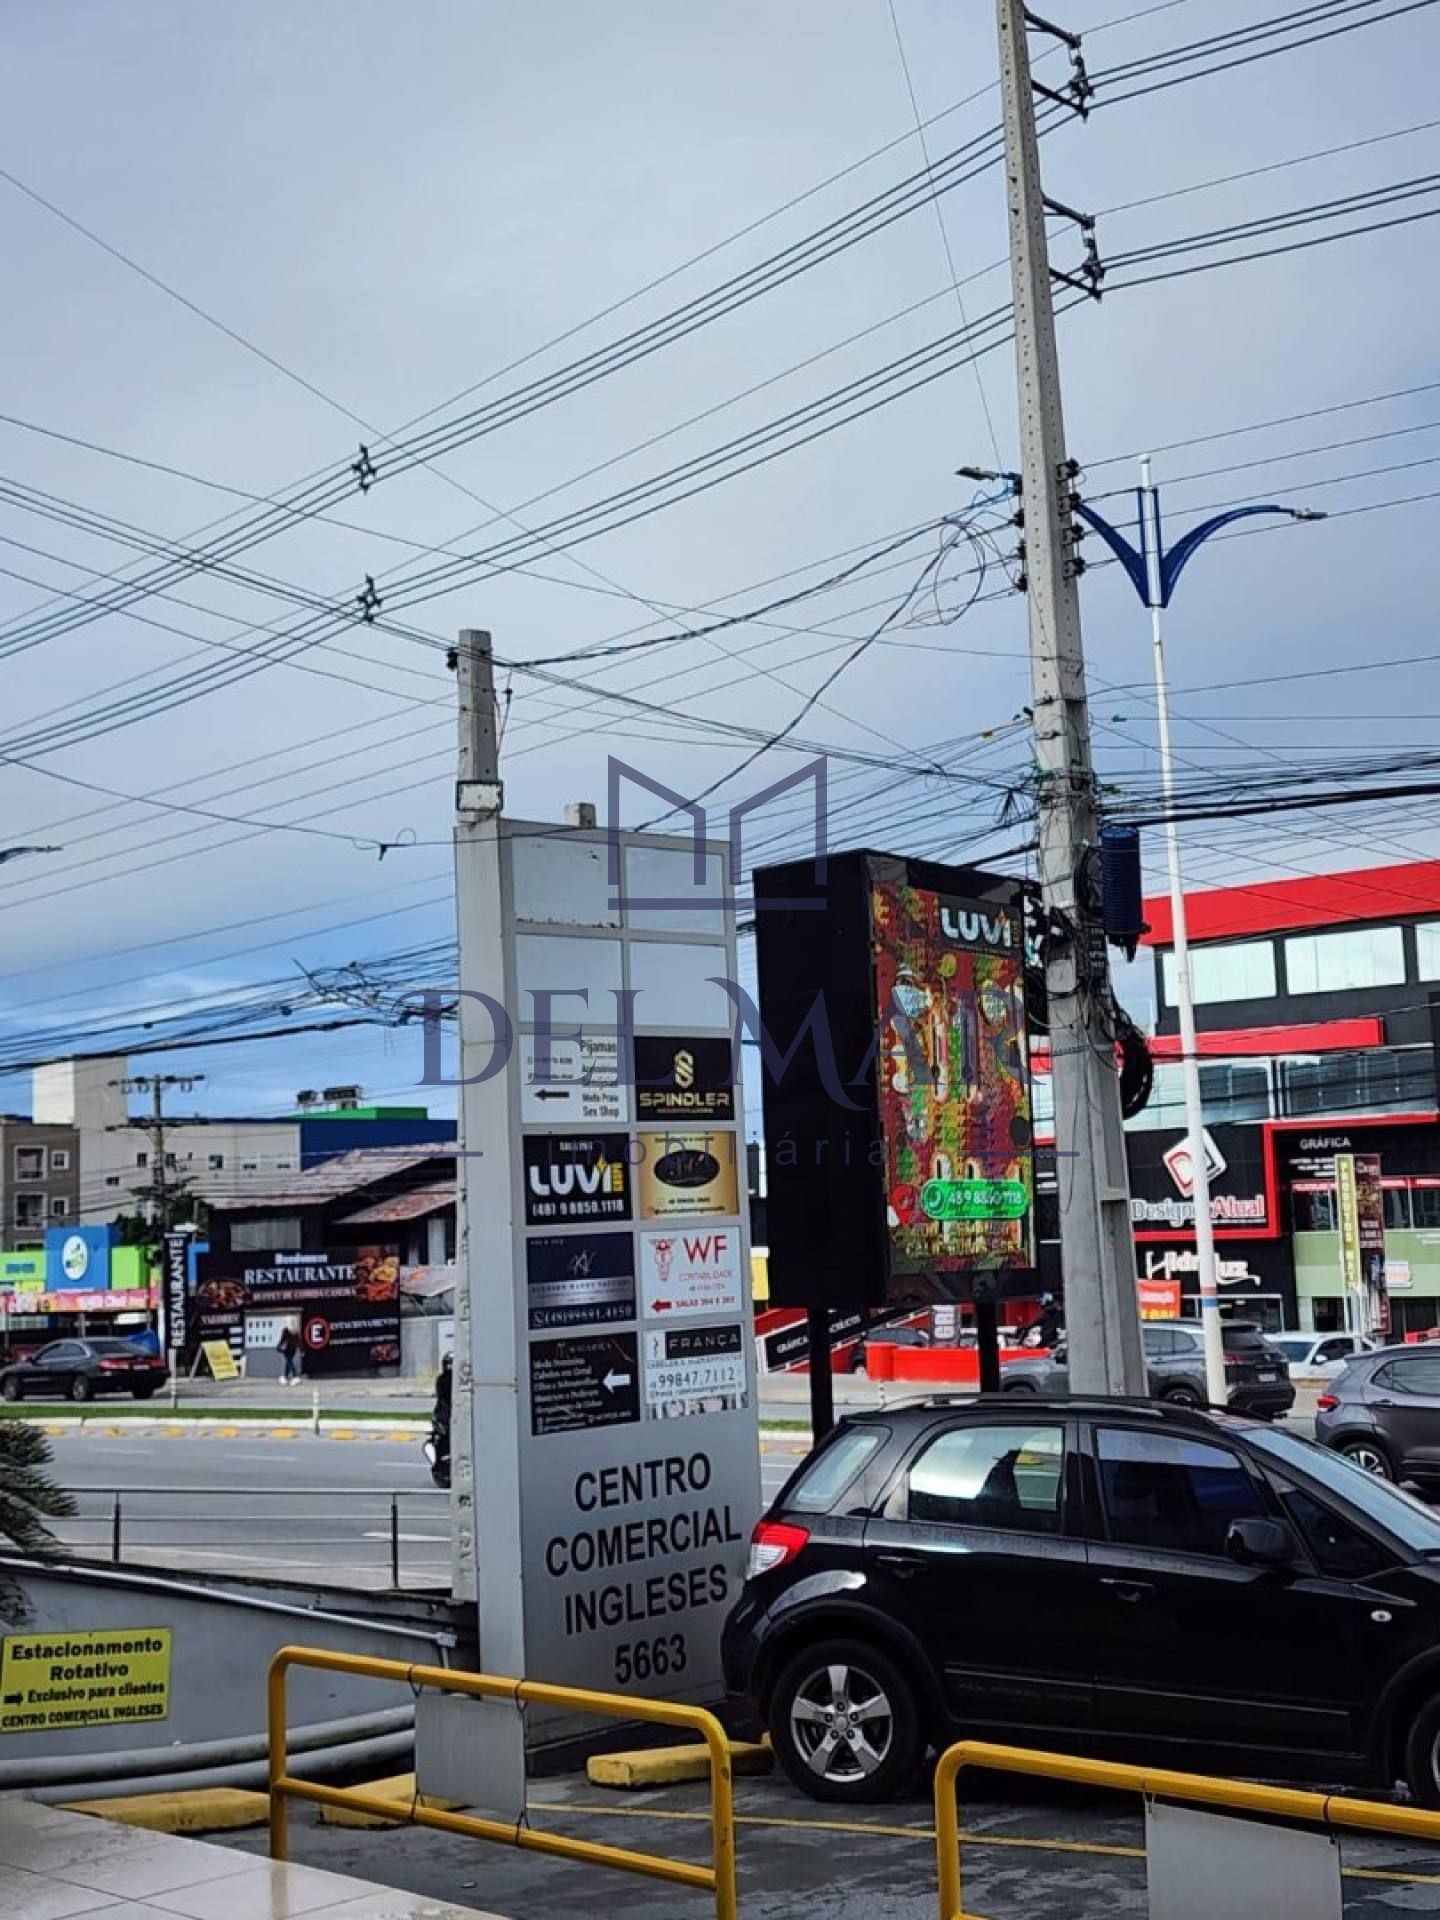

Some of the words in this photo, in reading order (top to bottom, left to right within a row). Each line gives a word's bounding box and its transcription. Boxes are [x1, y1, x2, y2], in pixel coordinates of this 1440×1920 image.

[639, 1092, 730, 1106] SPINDLER
[1300, 1135, 1351, 1149] GRÁFICA
[529, 1154, 611, 1196] LUVI
[683, 1235, 727, 1264] WF
[244, 1264, 357, 1285] RESTAURANTE
[170, 1237, 185, 1347] RESTAURANTE
[311, 1323, 322, 1342] E
[669, 1333, 739, 1351] FRANÇA
[575, 1452, 711, 1511] CENTRO
[545, 1505, 742, 1577] COMERCIAL
[564, 1564, 728, 1635] INGLESES
[11, 1637, 163, 1660] Estacionamento
[614, 1633, 687, 1684] 5663
[50, 1661, 129, 1681] Rotativo
[28, 1686, 86, 1704] Exclusivo
[89, 1687, 115, 1701] para
[119, 1682, 165, 1697] clientes
[2, 1713, 46, 1727] CENTRO
[49, 1707, 111, 1723] COMERCIAL
[113, 1703, 163, 1718] INGLESES
